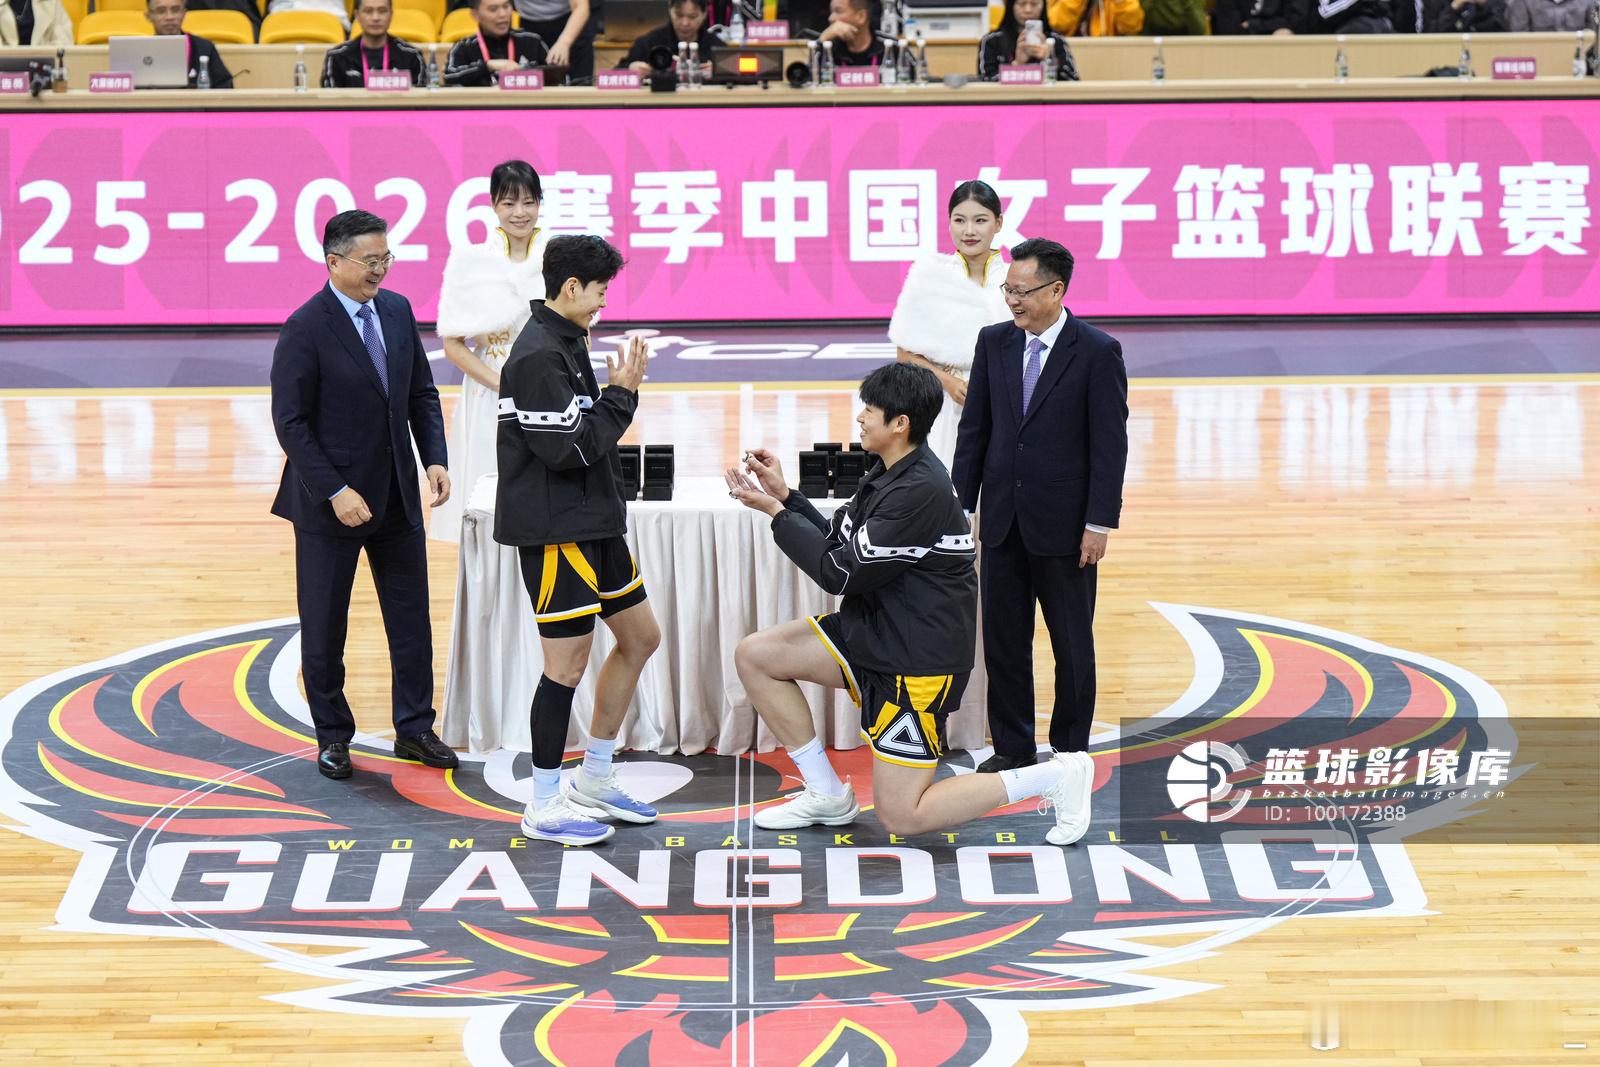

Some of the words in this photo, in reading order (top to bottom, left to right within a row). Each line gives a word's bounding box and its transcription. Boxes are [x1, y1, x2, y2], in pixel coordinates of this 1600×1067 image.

[0, 162, 1590, 265] 25-2026赛季中国女子篮球联赛
[126, 829, 1375, 914] GUANGDONG
[328, 838, 583, 850] WOME
[665, 831, 1178, 847] BASKETBLL
